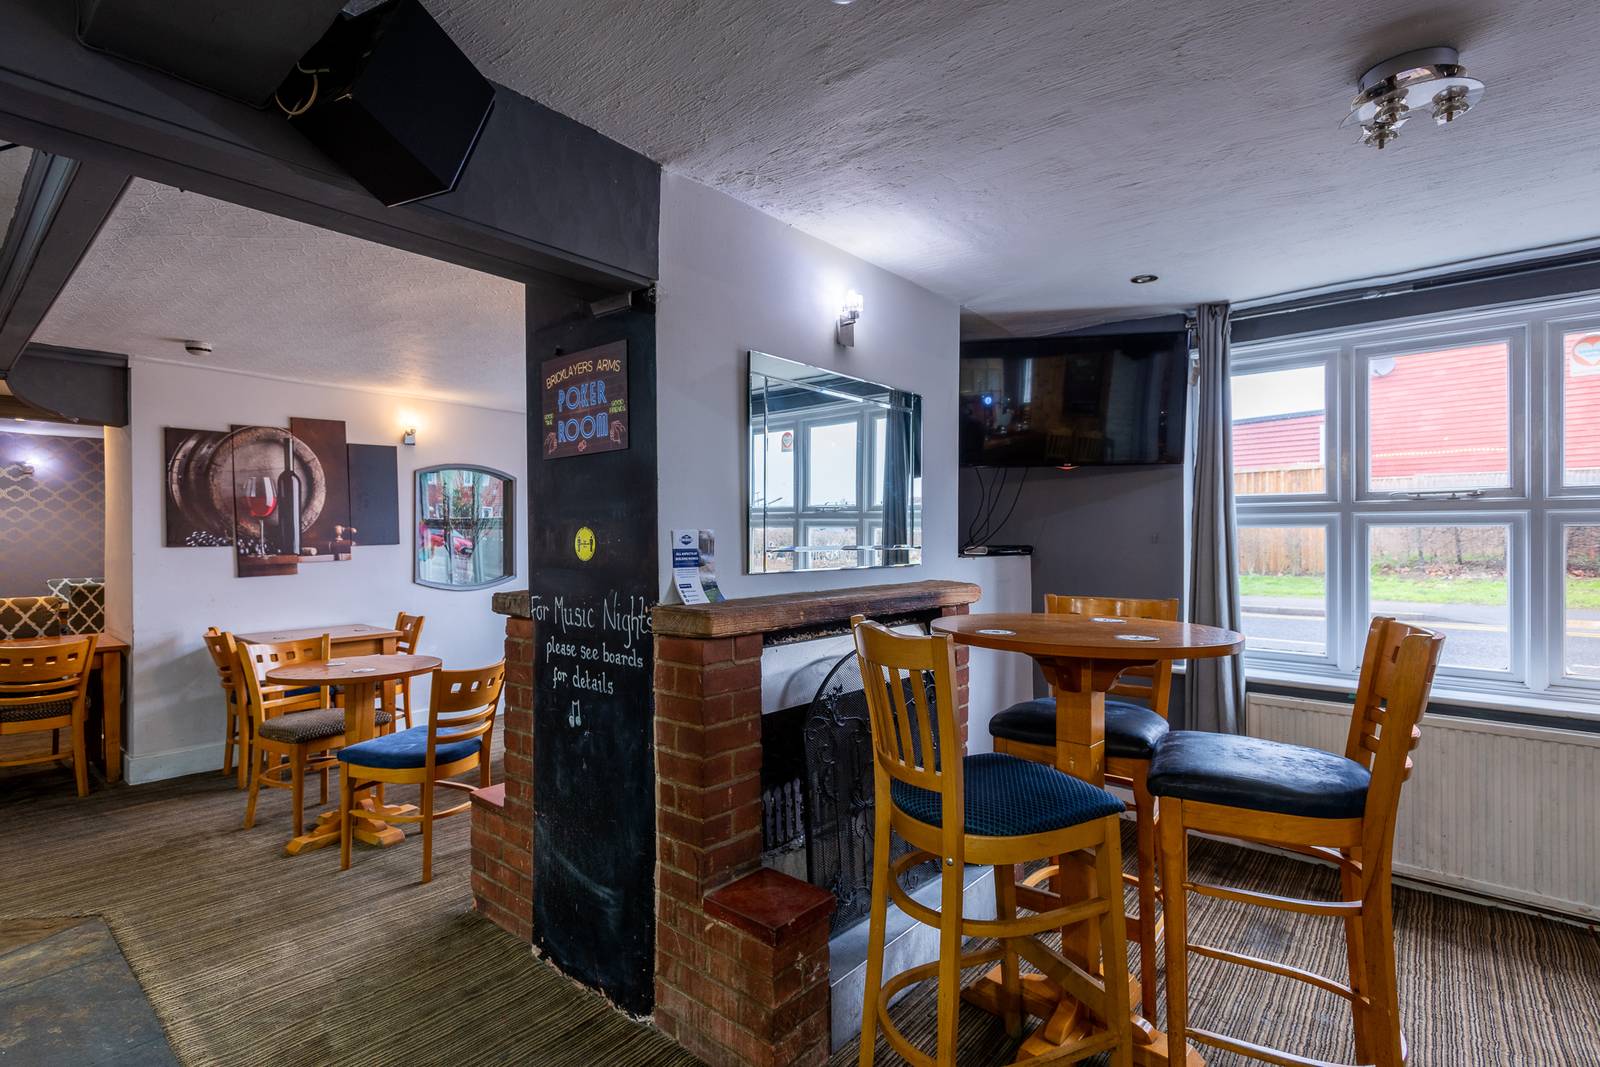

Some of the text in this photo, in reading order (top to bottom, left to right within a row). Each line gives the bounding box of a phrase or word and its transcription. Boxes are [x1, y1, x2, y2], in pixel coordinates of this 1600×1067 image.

[546, 359, 621, 390] BRICKLAYERS ARMS
[558, 380, 607, 412] POKER
[558, 412, 609, 443] ROOM
[531, 595, 549, 621] For
[554, 596, 595, 634] Music
[546, 635, 644, 668] please see boards
[552, 664, 614, 695] for details
